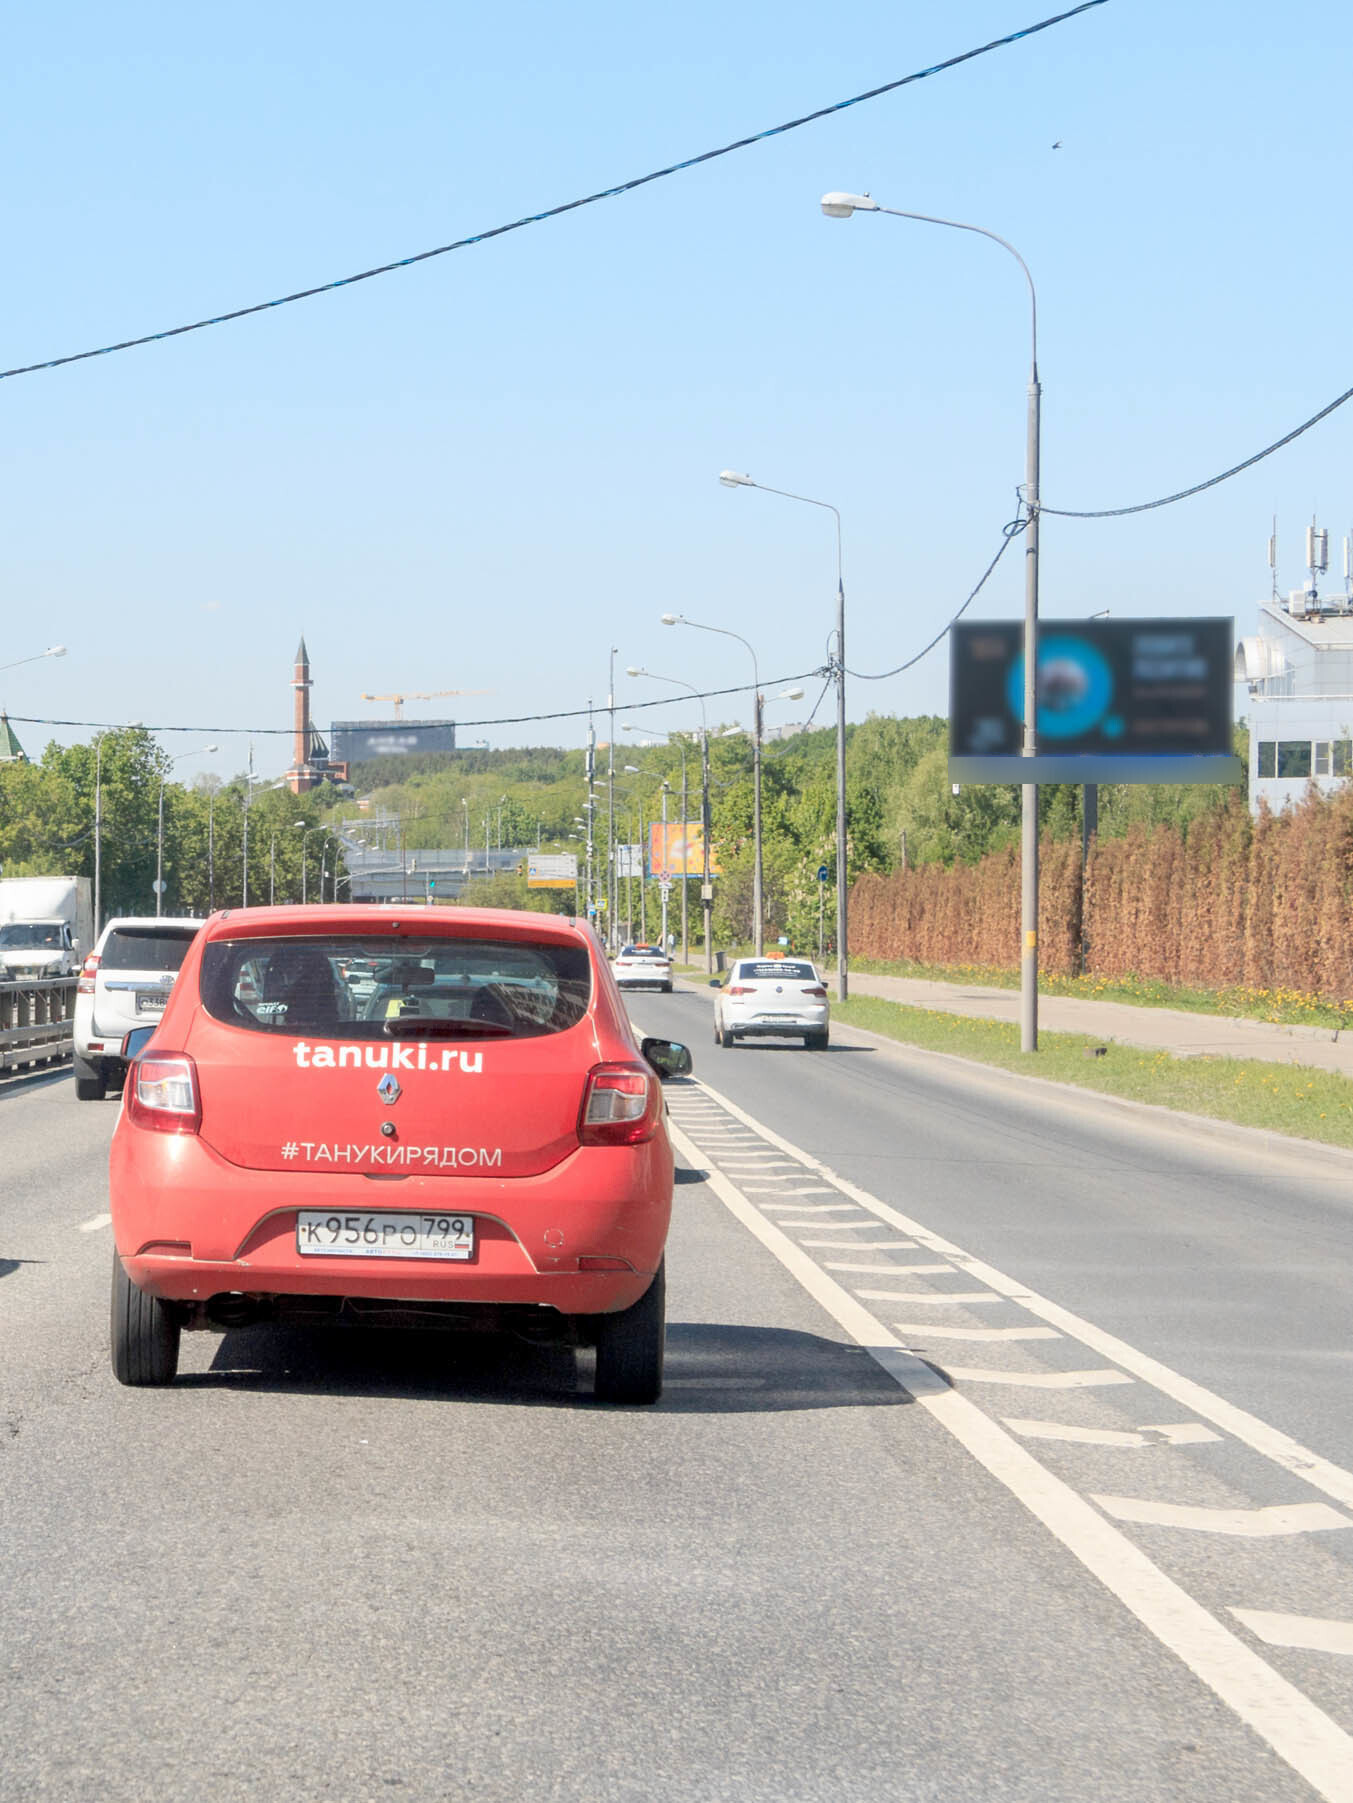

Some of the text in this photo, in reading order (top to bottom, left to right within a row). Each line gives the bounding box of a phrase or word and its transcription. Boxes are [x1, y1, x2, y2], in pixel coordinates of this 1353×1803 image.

[293, 1042, 483, 1072] tanuki.ru
[281, 1142, 503, 1168] #ТАНУКИРЯДОМ
[432, 1240, 454, 1249] RUS
